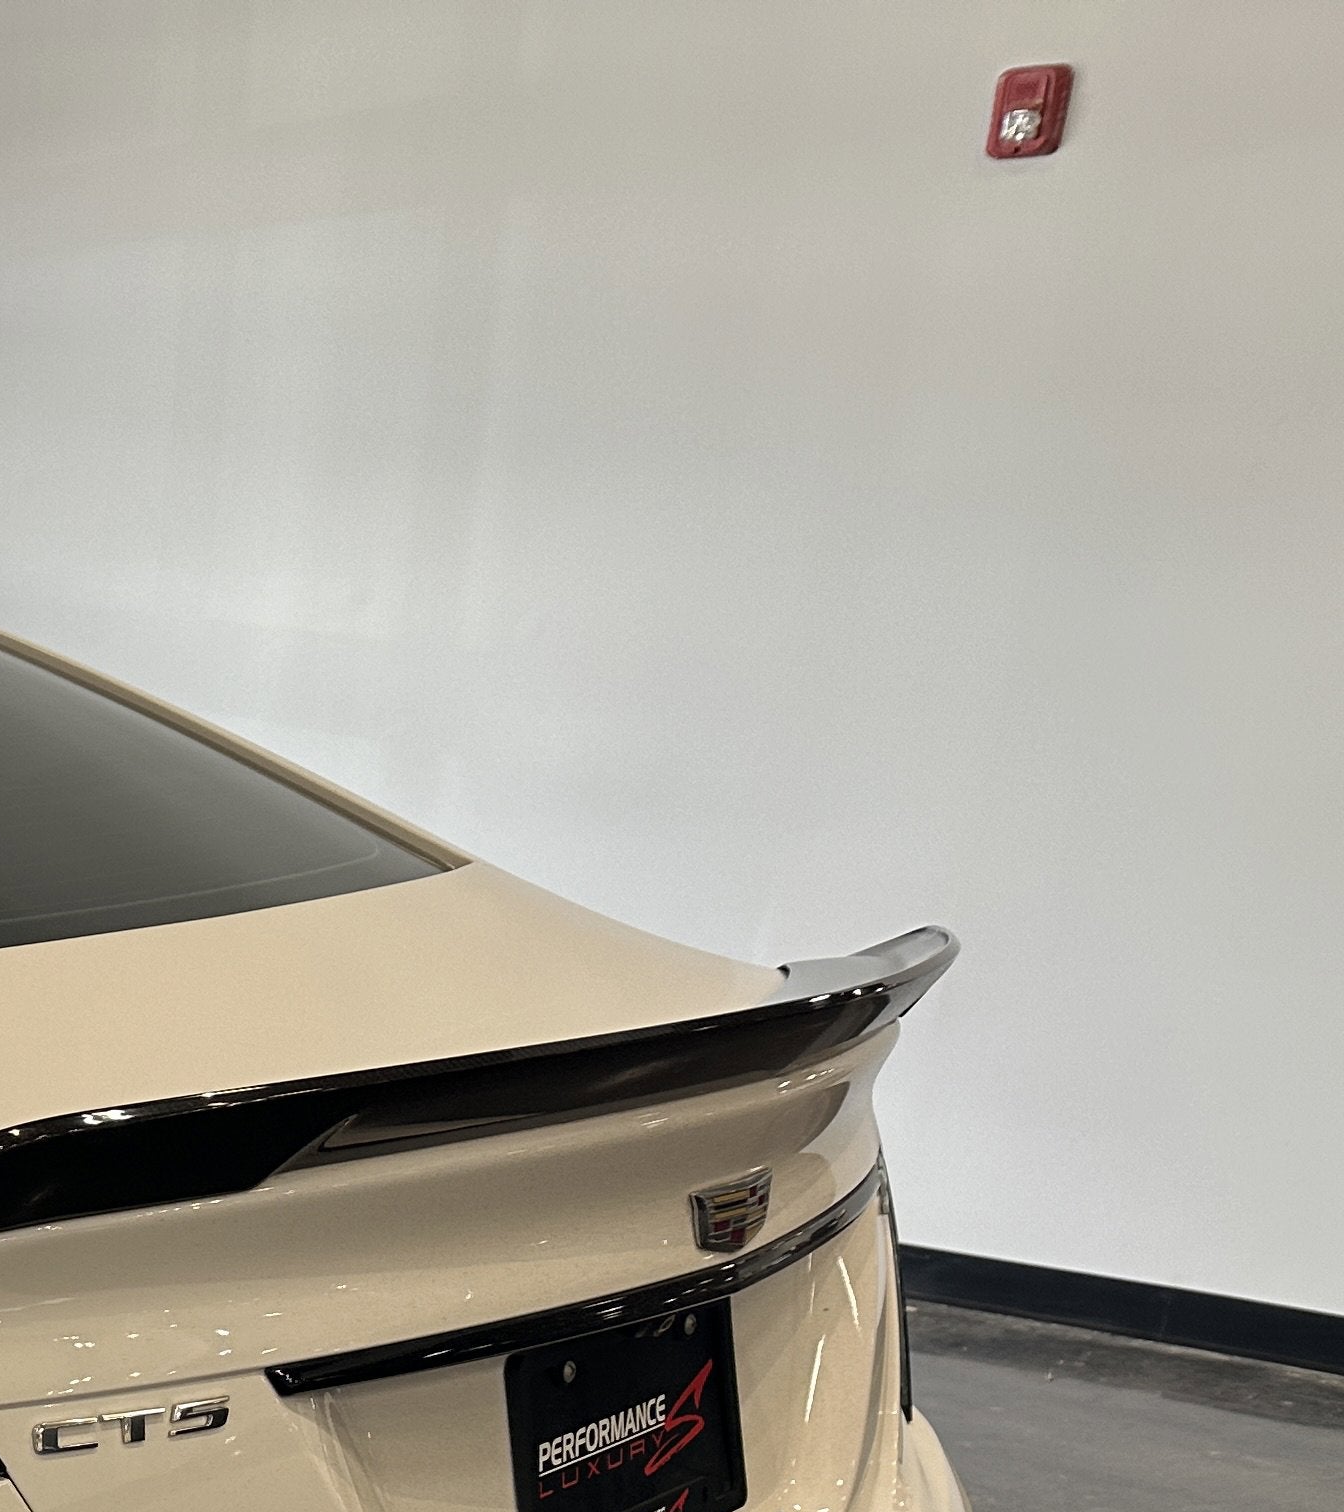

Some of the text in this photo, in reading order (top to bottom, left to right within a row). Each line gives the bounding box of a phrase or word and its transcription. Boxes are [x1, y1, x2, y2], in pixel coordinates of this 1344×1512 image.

[31, 1395, 230, 1455] CT5
[538, 1394, 666, 1473] PERFORMANCE
[538, 1430, 665, 1499] LUXURY
